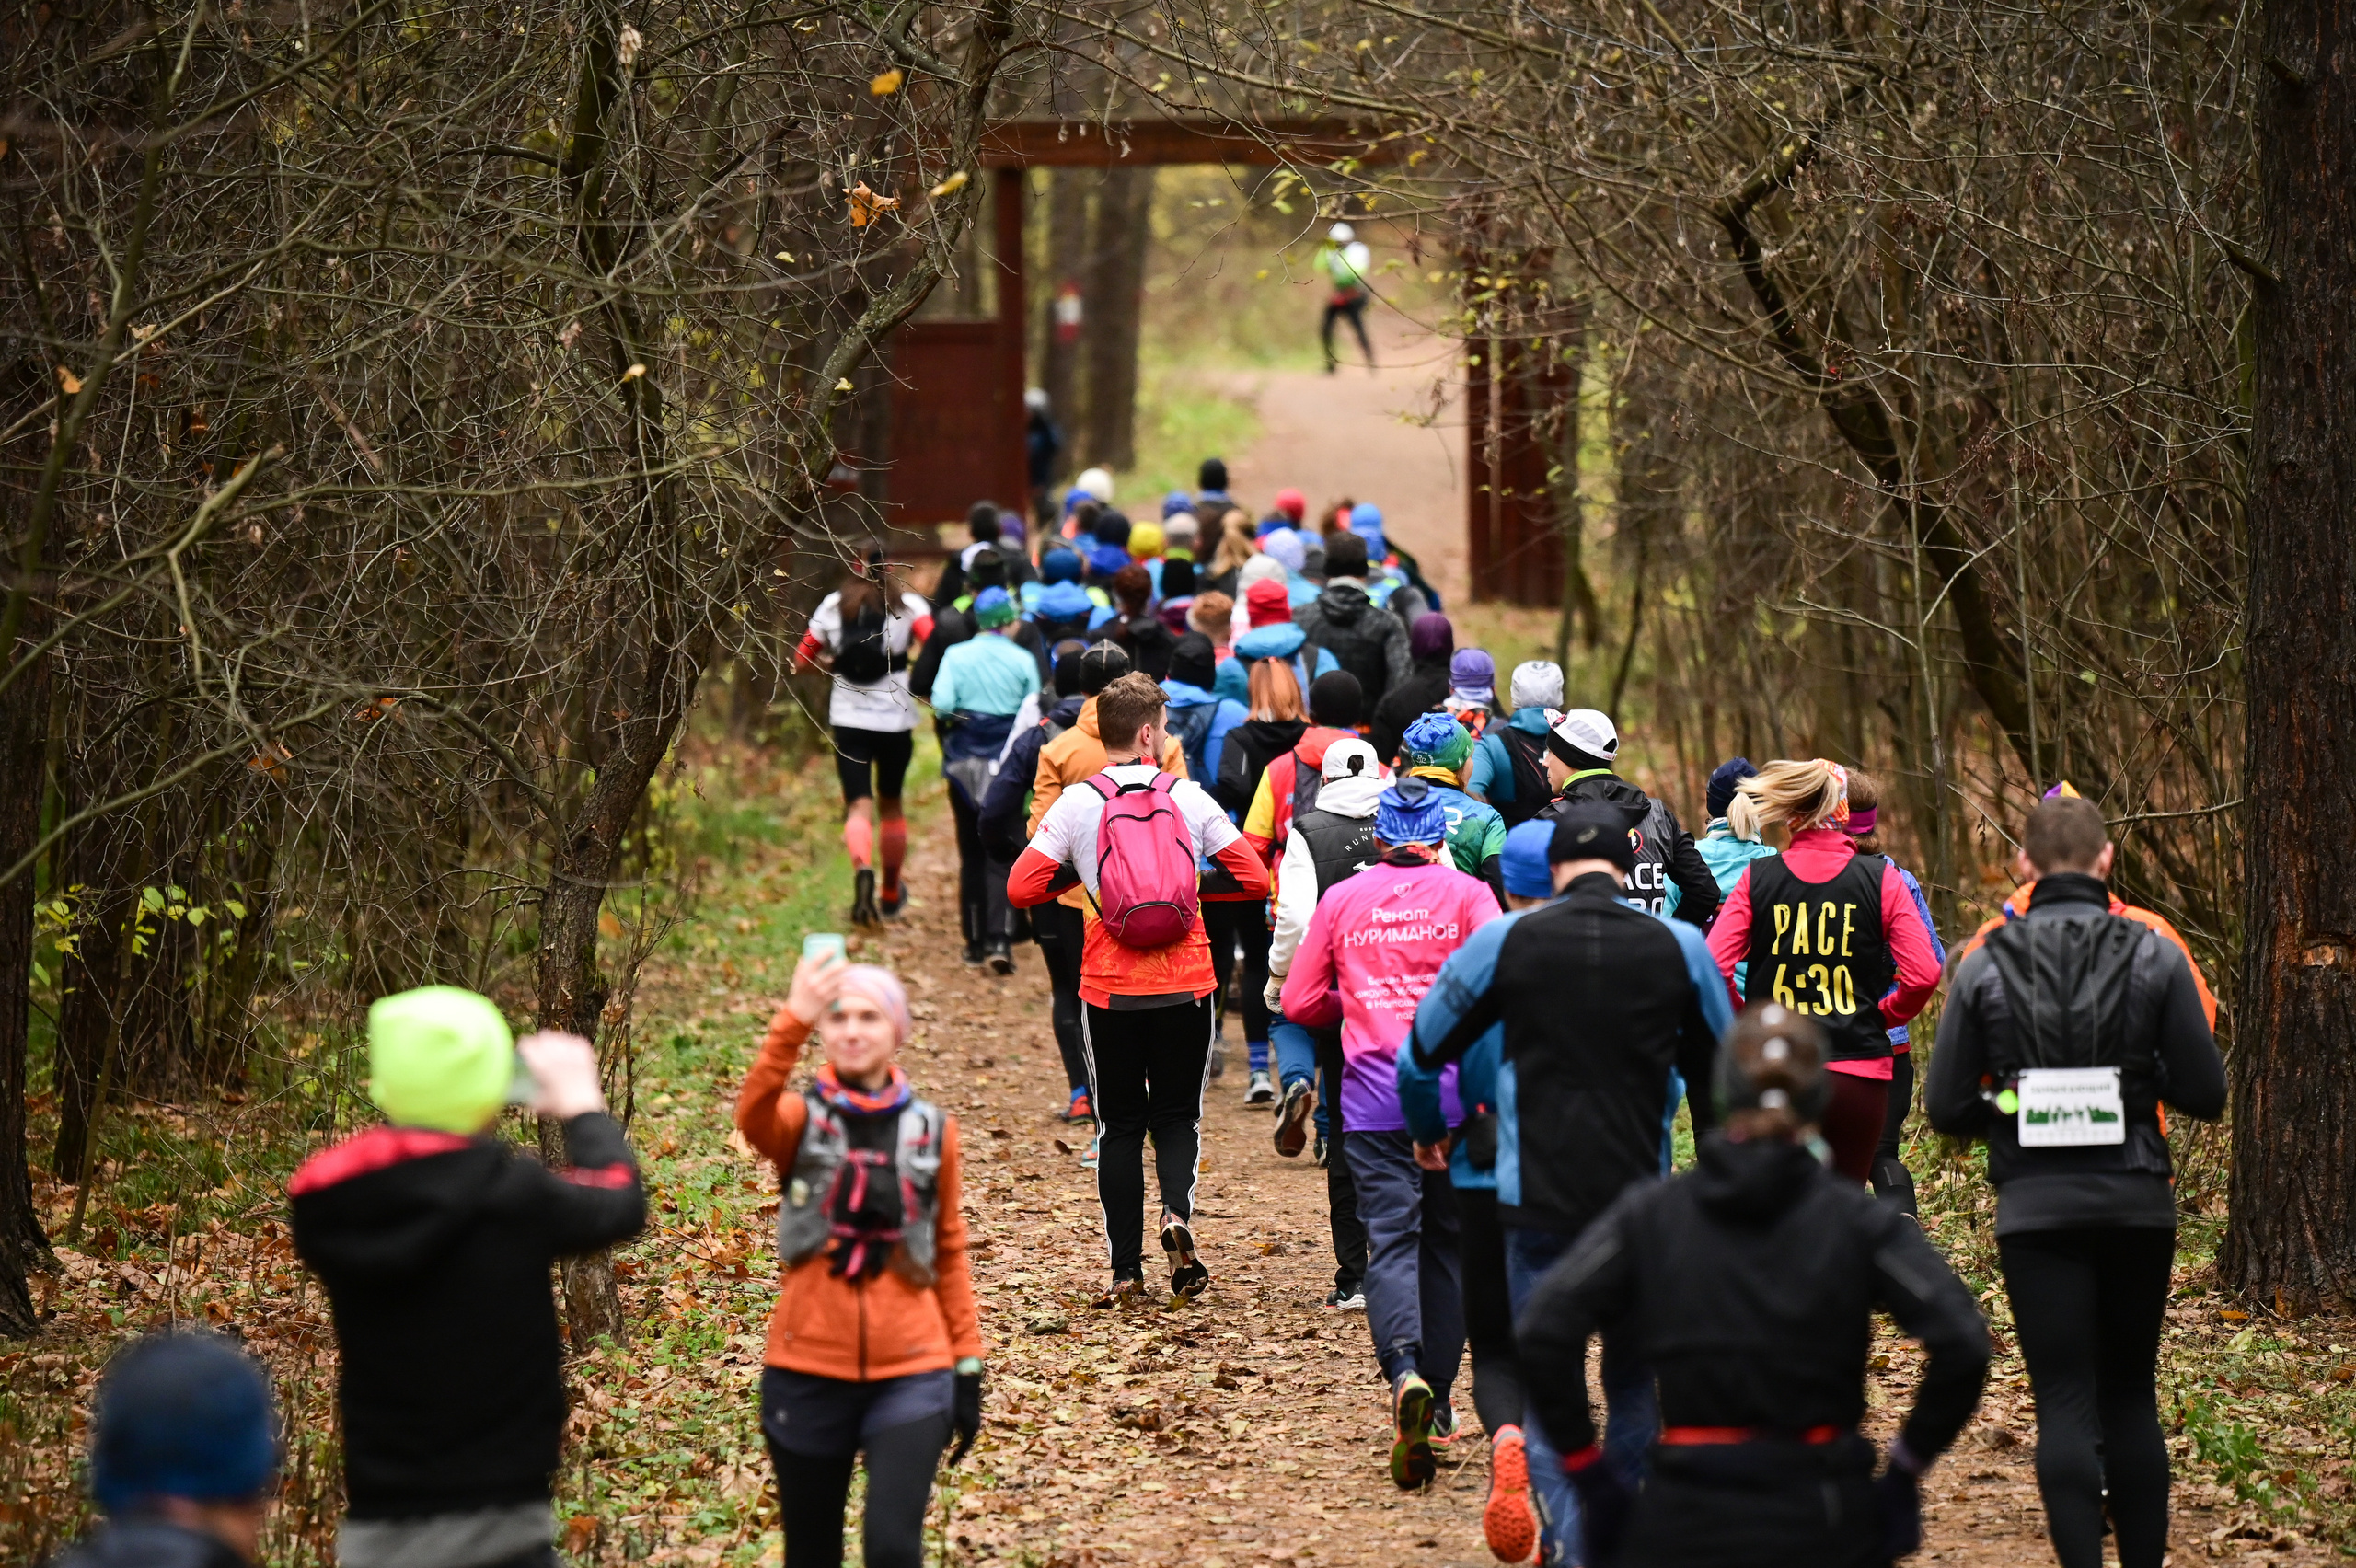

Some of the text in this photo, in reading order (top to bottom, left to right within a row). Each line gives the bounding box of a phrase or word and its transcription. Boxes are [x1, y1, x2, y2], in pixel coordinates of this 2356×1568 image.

[1371, 907, 1429, 923] Ренат
[1771, 901, 1857, 957] PACE
[1344, 923, 1460, 948] НУРИМАНОВ
[1773, 963, 1857, 1016] 6:30
